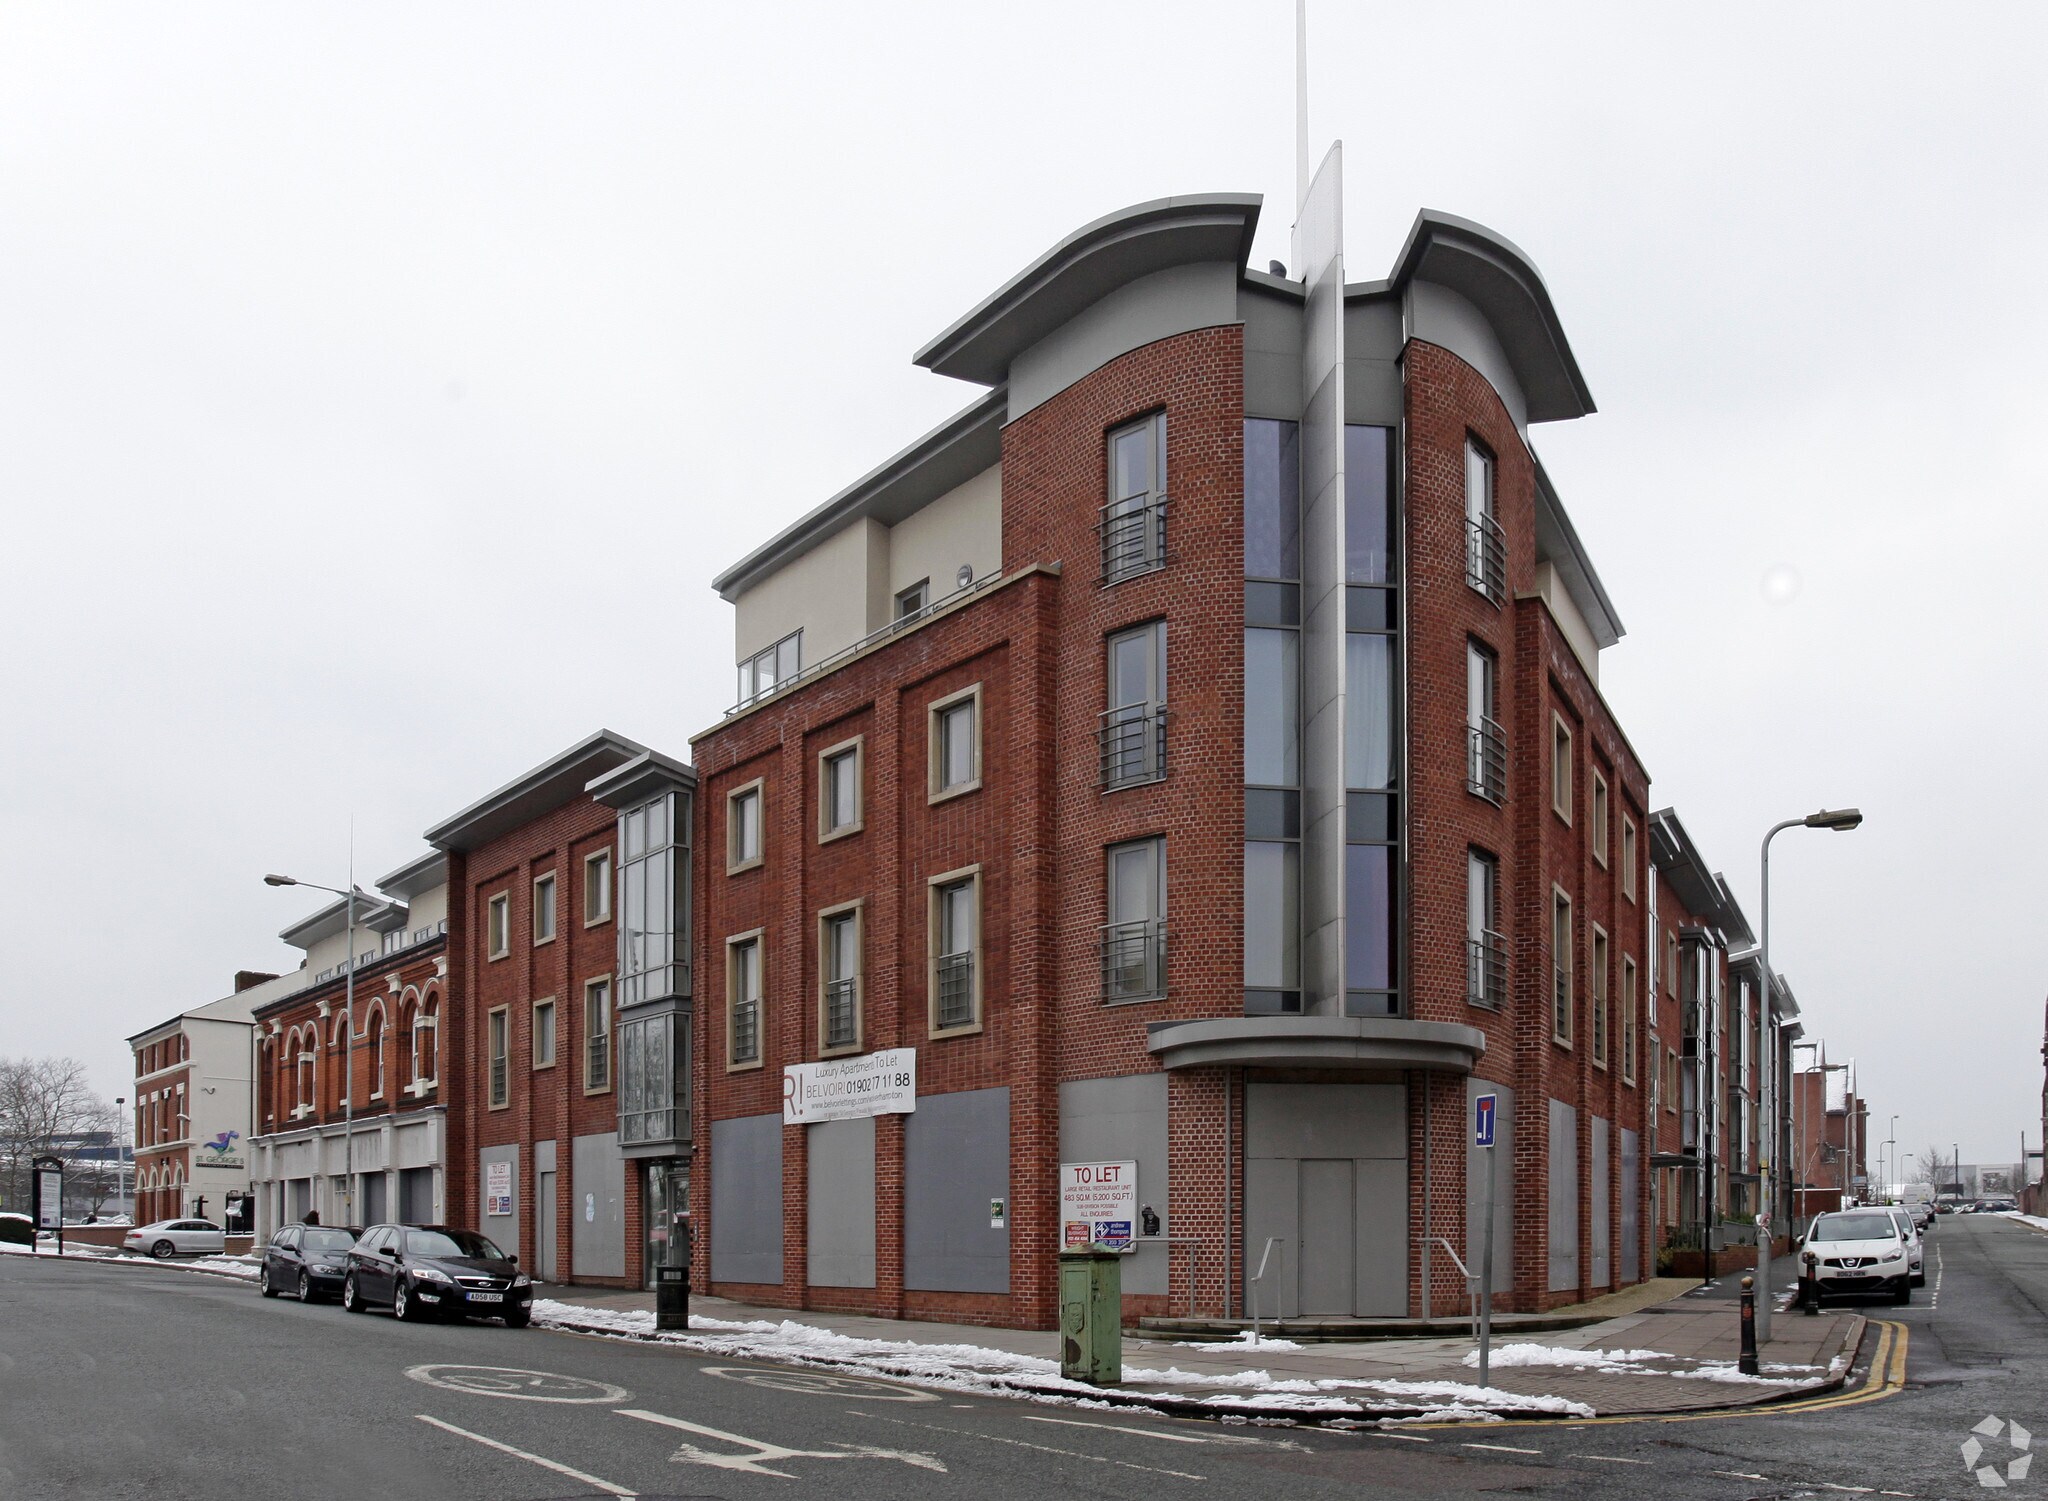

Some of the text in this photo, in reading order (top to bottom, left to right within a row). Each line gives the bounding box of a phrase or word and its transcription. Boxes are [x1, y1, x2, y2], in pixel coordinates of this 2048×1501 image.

[816, 1066, 838, 1078] Luxury
[875, 1056, 884, 1068] To
[886, 1054, 898, 1066] Let
[1074, 1166, 1121, 1183] TO LET
